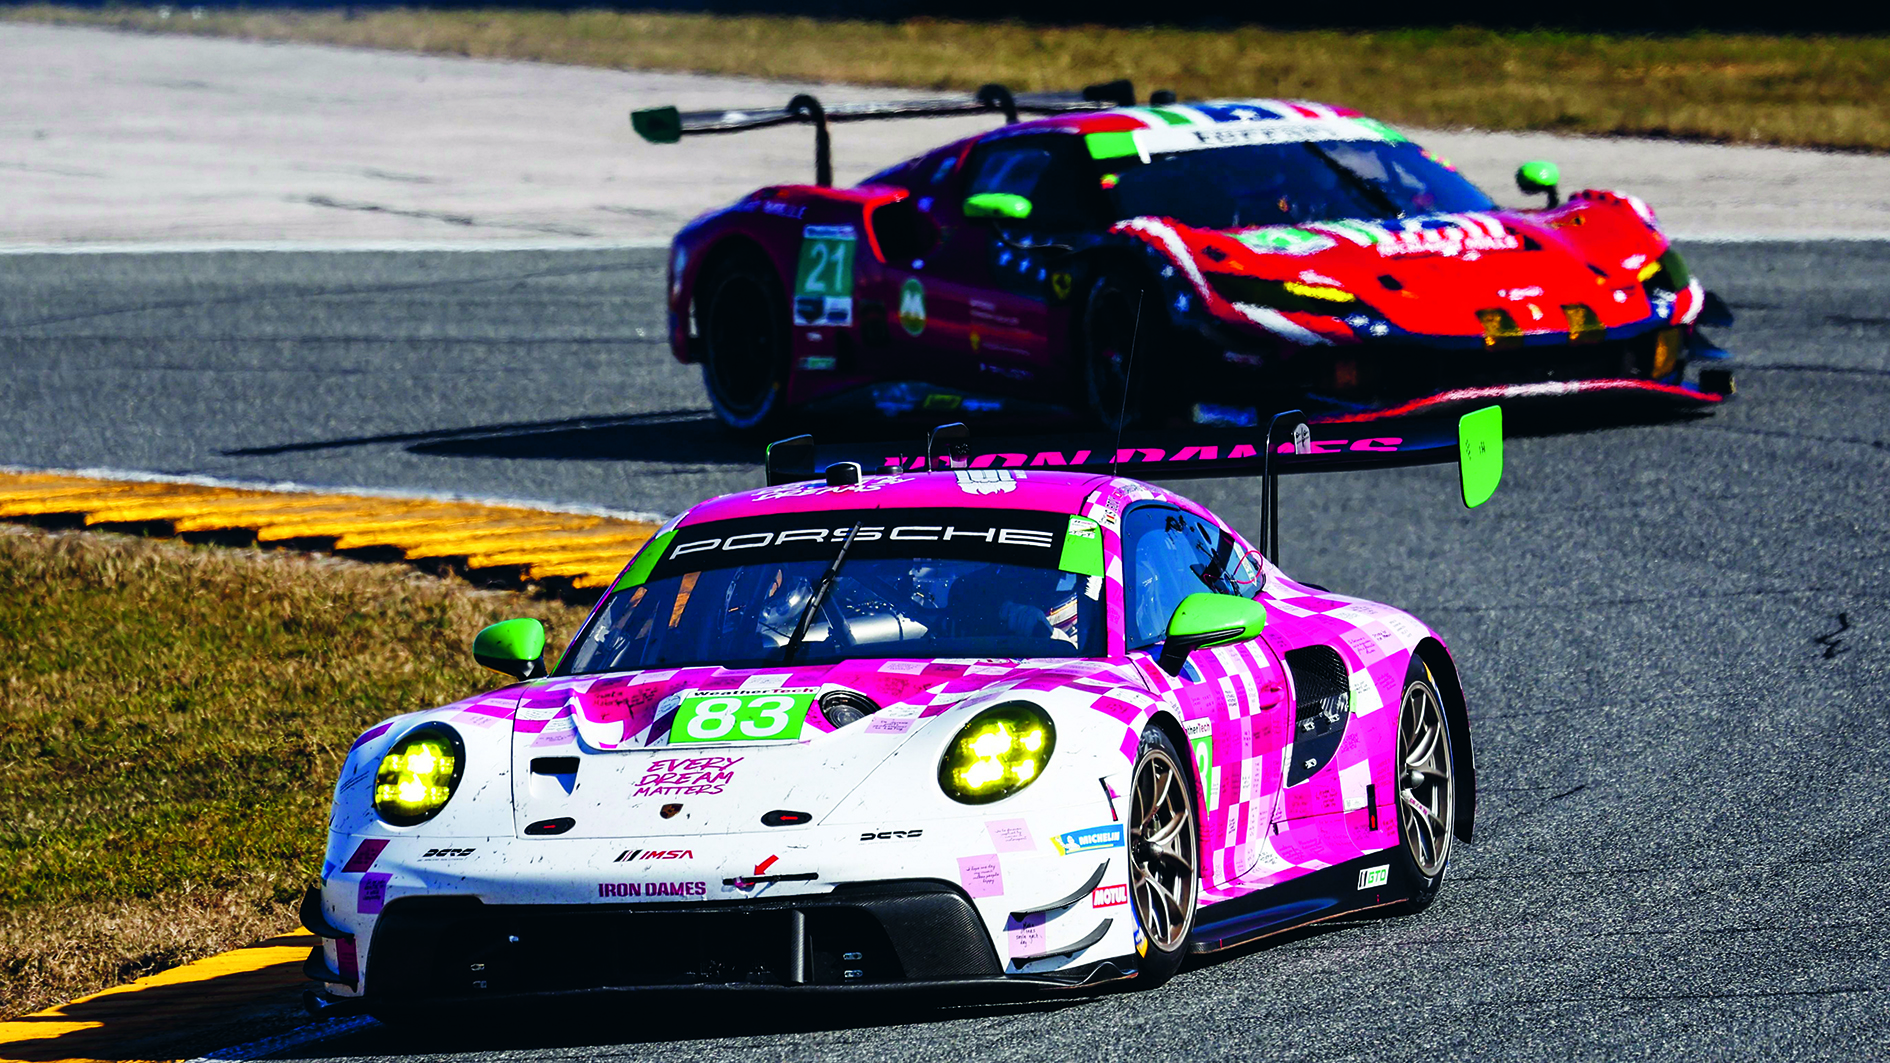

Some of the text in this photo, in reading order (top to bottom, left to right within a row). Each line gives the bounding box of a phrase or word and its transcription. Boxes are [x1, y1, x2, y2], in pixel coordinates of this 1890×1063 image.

[804, 242, 846, 293] 21
[669, 526, 1054, 561] PORSCHE
[694, 687, 814, 697] WeatherTech
[686, 696, 796, 739] 83
[646, 757, 745, 772] EVERY
[635, 771, 735, 786] DREAM
[633, 784, 726, 797] MATTERS
[1078, 831, 1120, 846] MICHELIN
[639, 849, 694, 860] IMSA
[1367, 868, 1388, 884] GTD
[599, 881, 707, 898] IRON DAMES
[1094, 886, 1127, 906] MOTUL
